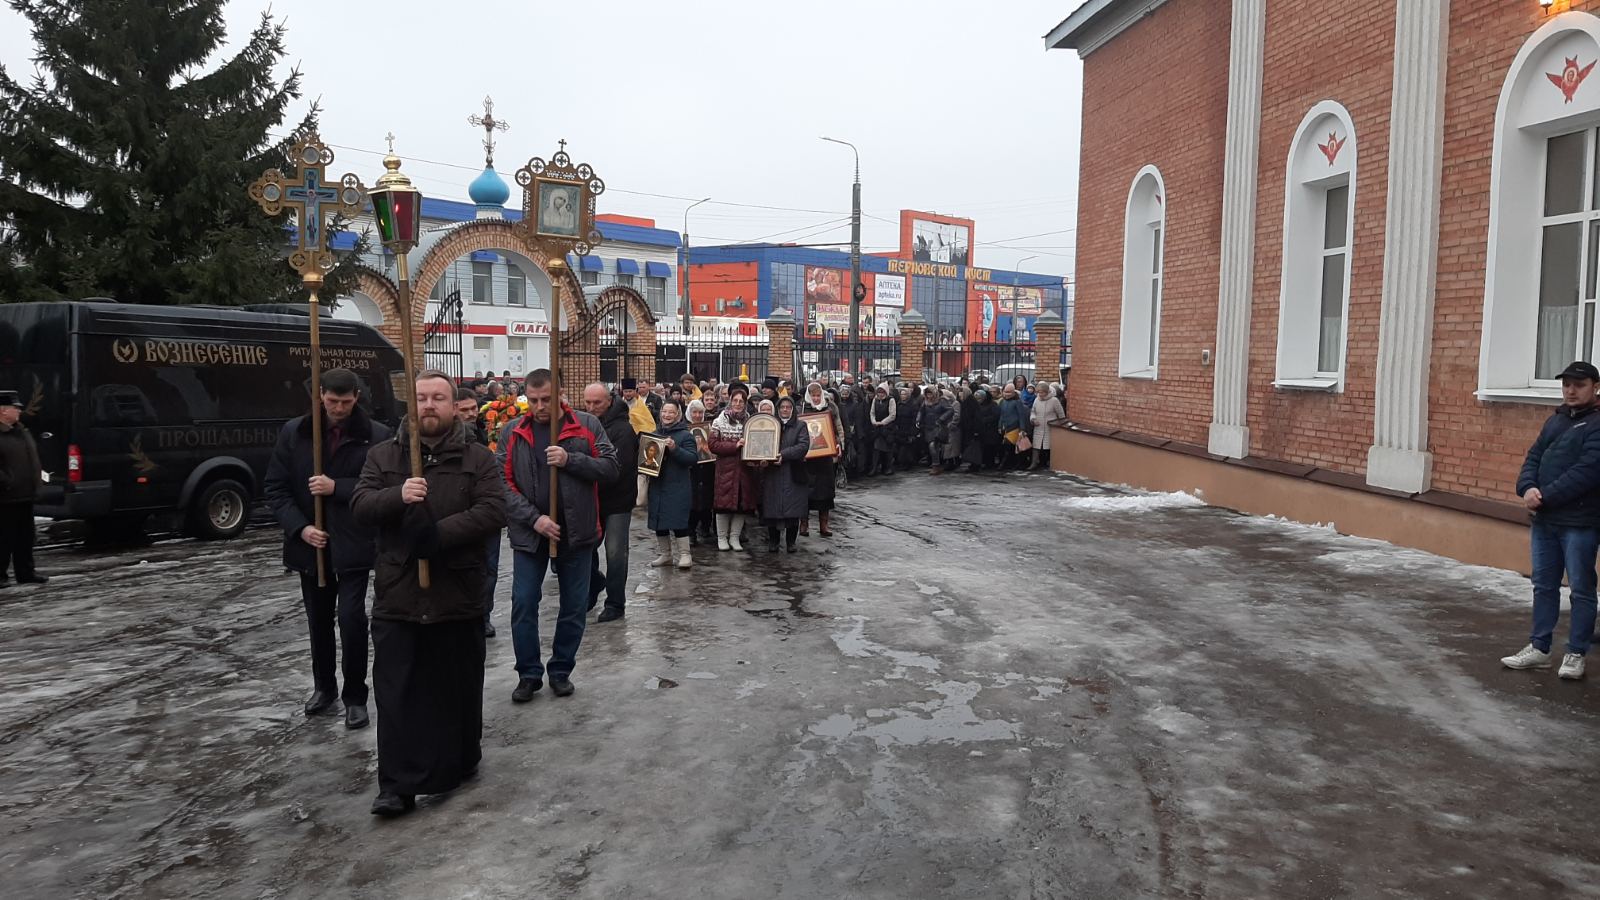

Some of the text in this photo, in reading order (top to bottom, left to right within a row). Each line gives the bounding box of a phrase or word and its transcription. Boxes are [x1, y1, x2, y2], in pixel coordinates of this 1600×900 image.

[878, 281, 902, 290] АПТЕКА
[514, 323, 549, 334] МАГН
[144, 340, 268, 365] ВОЗНЕСЕНИЕ
[289, 346, 377, 358] РИТУЬНАЯ СЛУЖБА
[331, 358, 370, 369] 73-93-93
[159, 427, 280, 448] ПРОЩАЛЬНЫ
